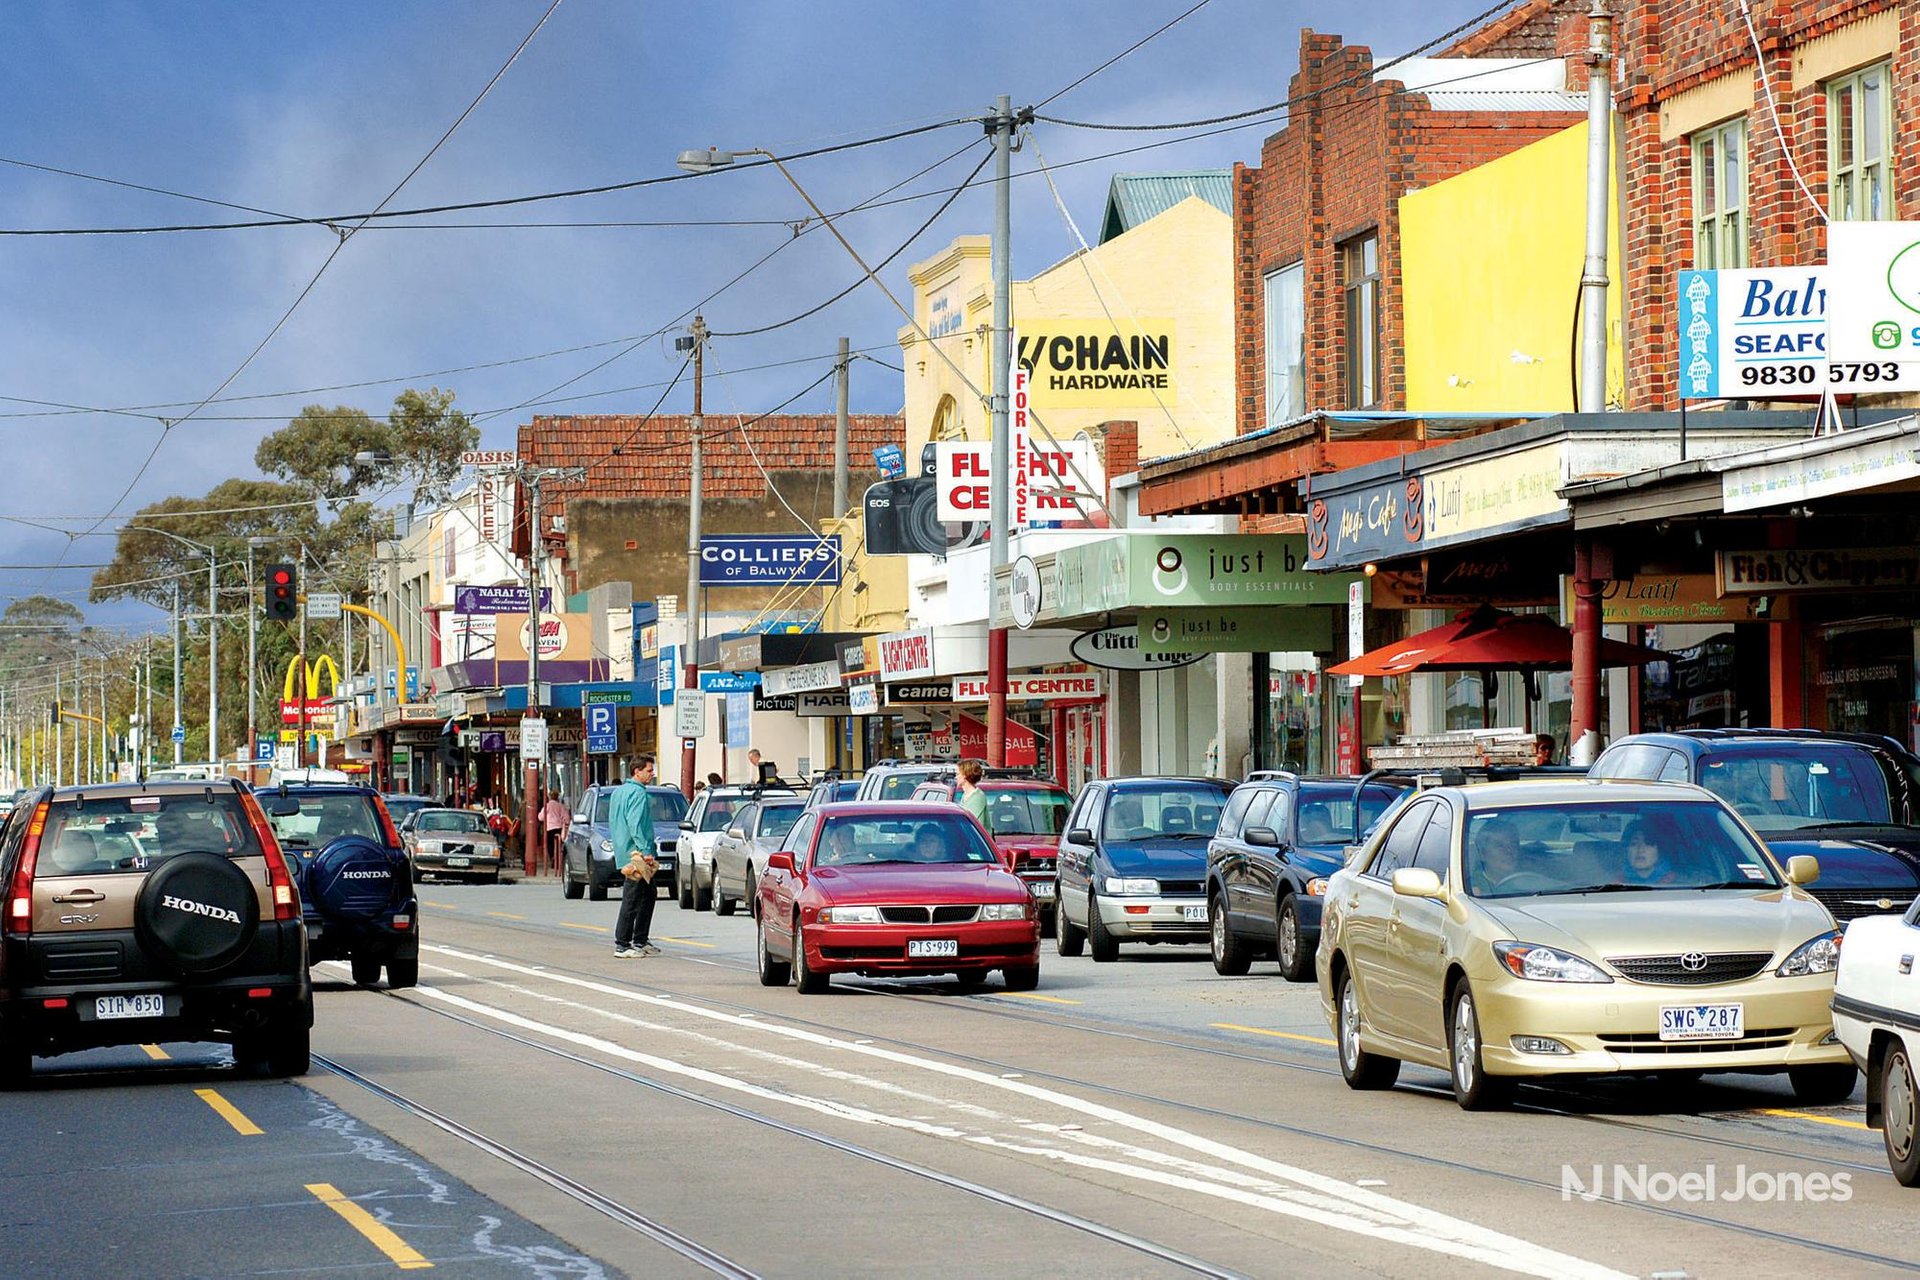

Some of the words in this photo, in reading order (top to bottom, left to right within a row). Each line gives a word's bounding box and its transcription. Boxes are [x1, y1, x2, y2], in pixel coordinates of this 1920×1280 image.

[1048, 334, 1169, 372] CHAIN
[1049, 374, 1169, 390] HARDWARE
[1741, 364, 1816, 386] 9830
[1828, 362, 1900, 383] 5793
[1015, 373, 1028, 428] FOR
[463, 452, 513, 462] OASIS
[951, 452, 1074, 478] FLHT
[1015, 433, 1028, 524] LEASE
[869, 499, 890, 508] EOS
[949, 485, 1076, 510] CERE
[701, 546, 830, 563] COLLIERS
[1209, 548, 1265, 580] just
[1283, 543, 1310, 573] b
[726, 567, 743, 576] OF
[749, 566, 807, 576] BALWYN
[479, 588, 514, 597] NARAI
[1209, 583, 1238, 592] BODY
[1245, 582, 1315, 592] ESSENTIALS
[1181, 619, 1211, 636] just
[1220, 616, 1238, 632] be
[707, 678, 735, 688] ANZ
[1024, 678, 1096, 694] CENTRE
[589, 695, 622, 703] ROCHESTER
[622, 694, 631, 702] RD
[592, 708, 610, 732] P
[259, 743, 271, 757] P
[342, 870, 392, 880] HONDA
[162, 895, 242, 925] HONDA
[59, 913, 98, 925] CR-V
[910, 941, 932, 953] PTS
[936, 941, 956, 953] 999
[98, 998, 125, 1014] SIH
[135, 996, 161, 1012] 850
[1663, 1010, 1695, 1028] SWG
[1708, 1008, 1739, 1027] 287
